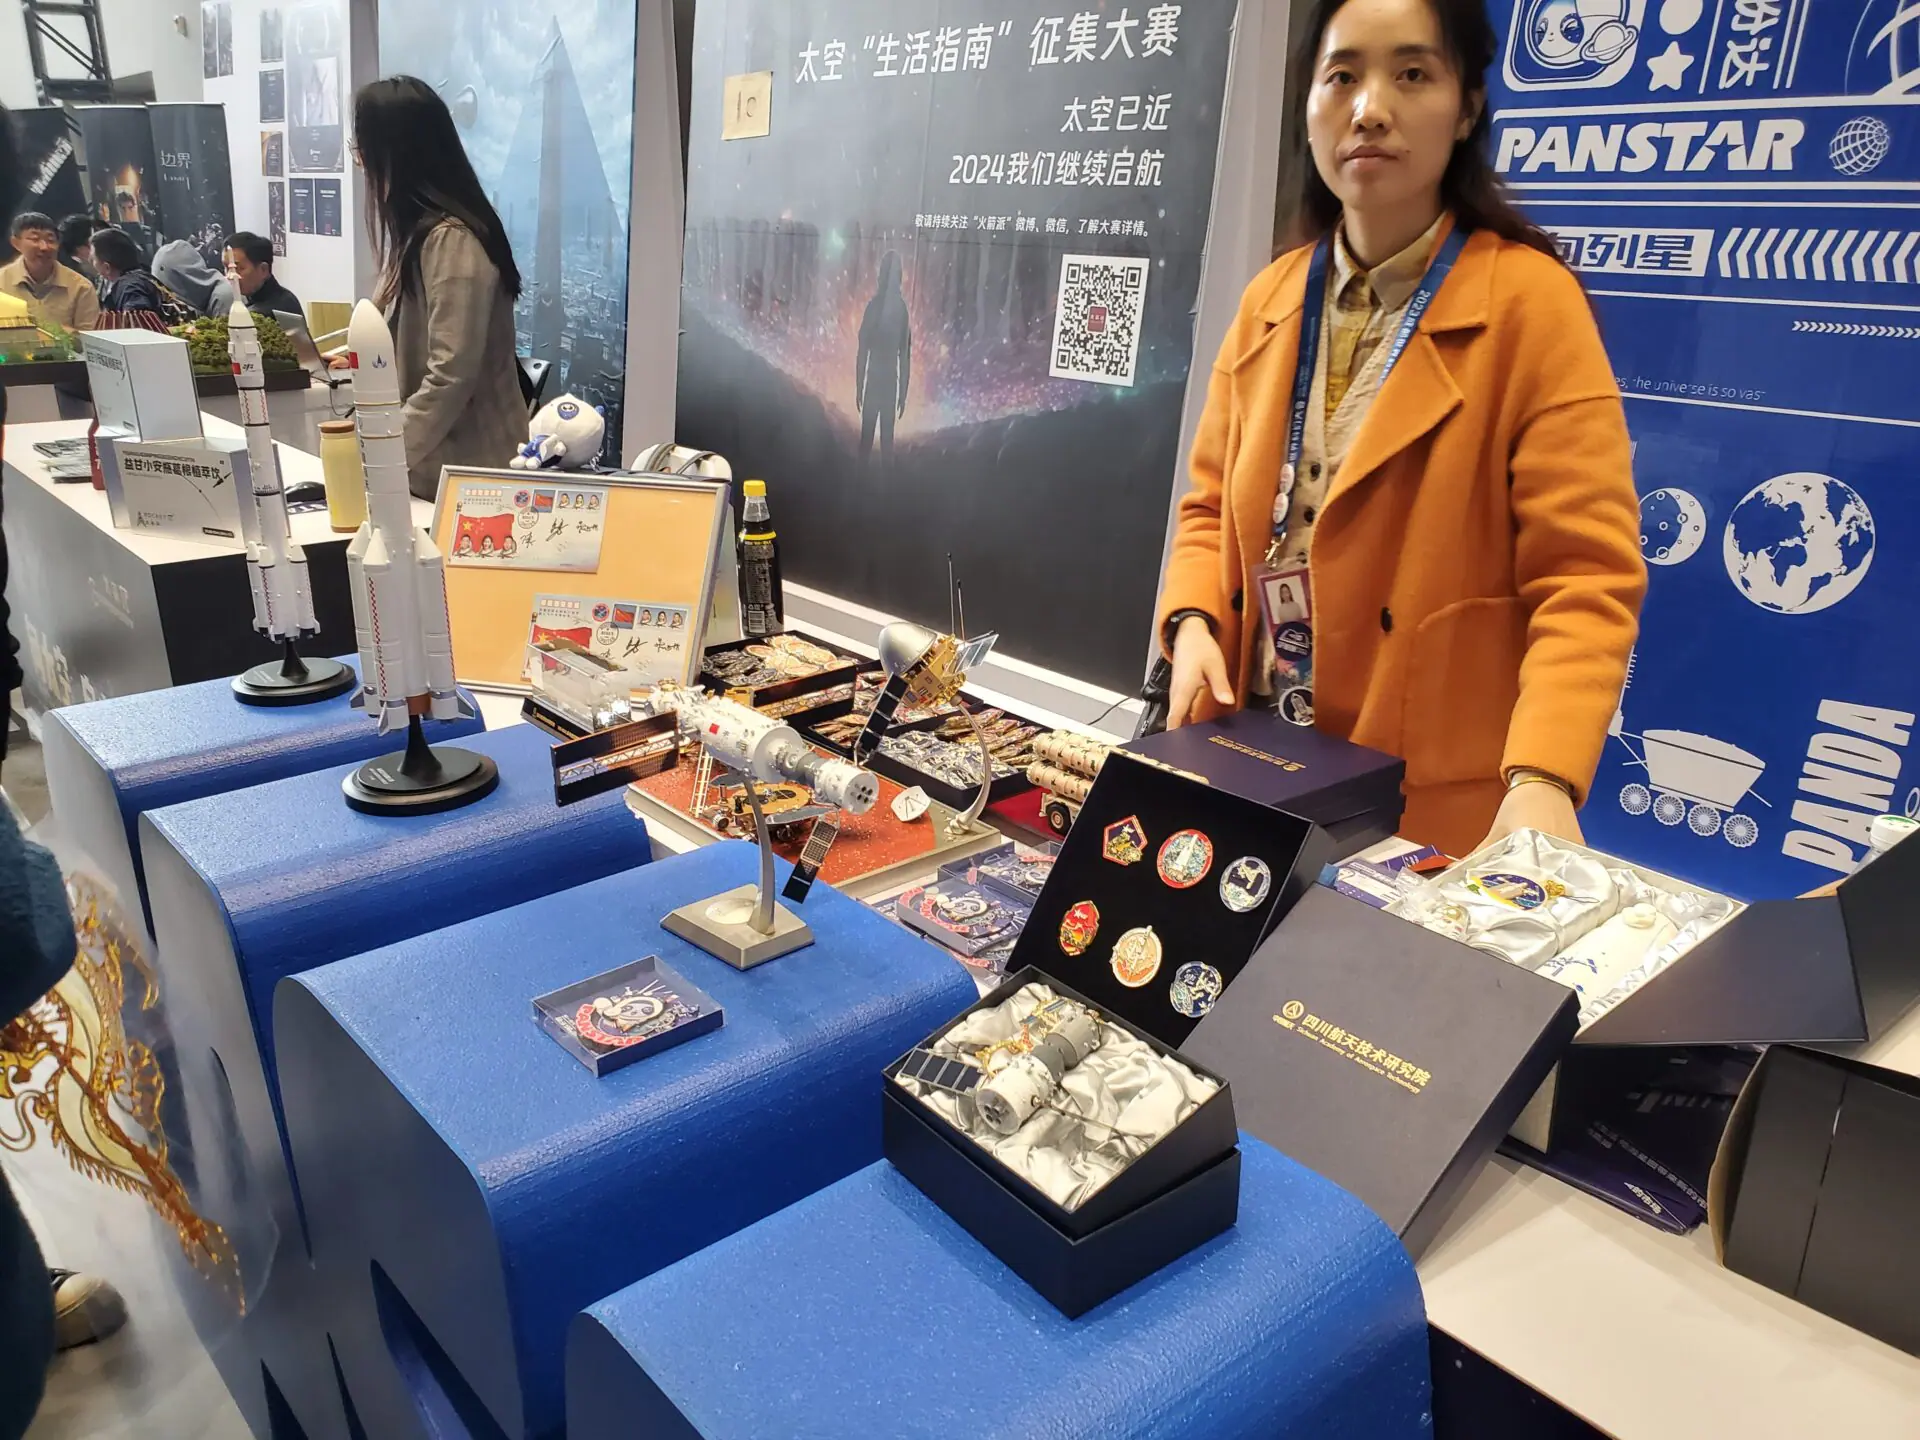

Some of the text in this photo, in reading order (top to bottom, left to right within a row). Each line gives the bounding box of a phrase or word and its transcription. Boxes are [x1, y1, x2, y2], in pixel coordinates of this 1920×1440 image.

[1061, 93, 1171, 132] 太空已近
[160, 149, 192, 170] 边界
[1495, 119, 1804, 173] PANSTAR
[948, 150, 1165, 187] 2024我们继续启航
[1708, 383, 1719, 397] is
[1720, 386, 1737, 398] so
[1781, 698, 1916, 874] PANDA
[1303, 1013, 1432, 1086] 四川航天技术研究院
